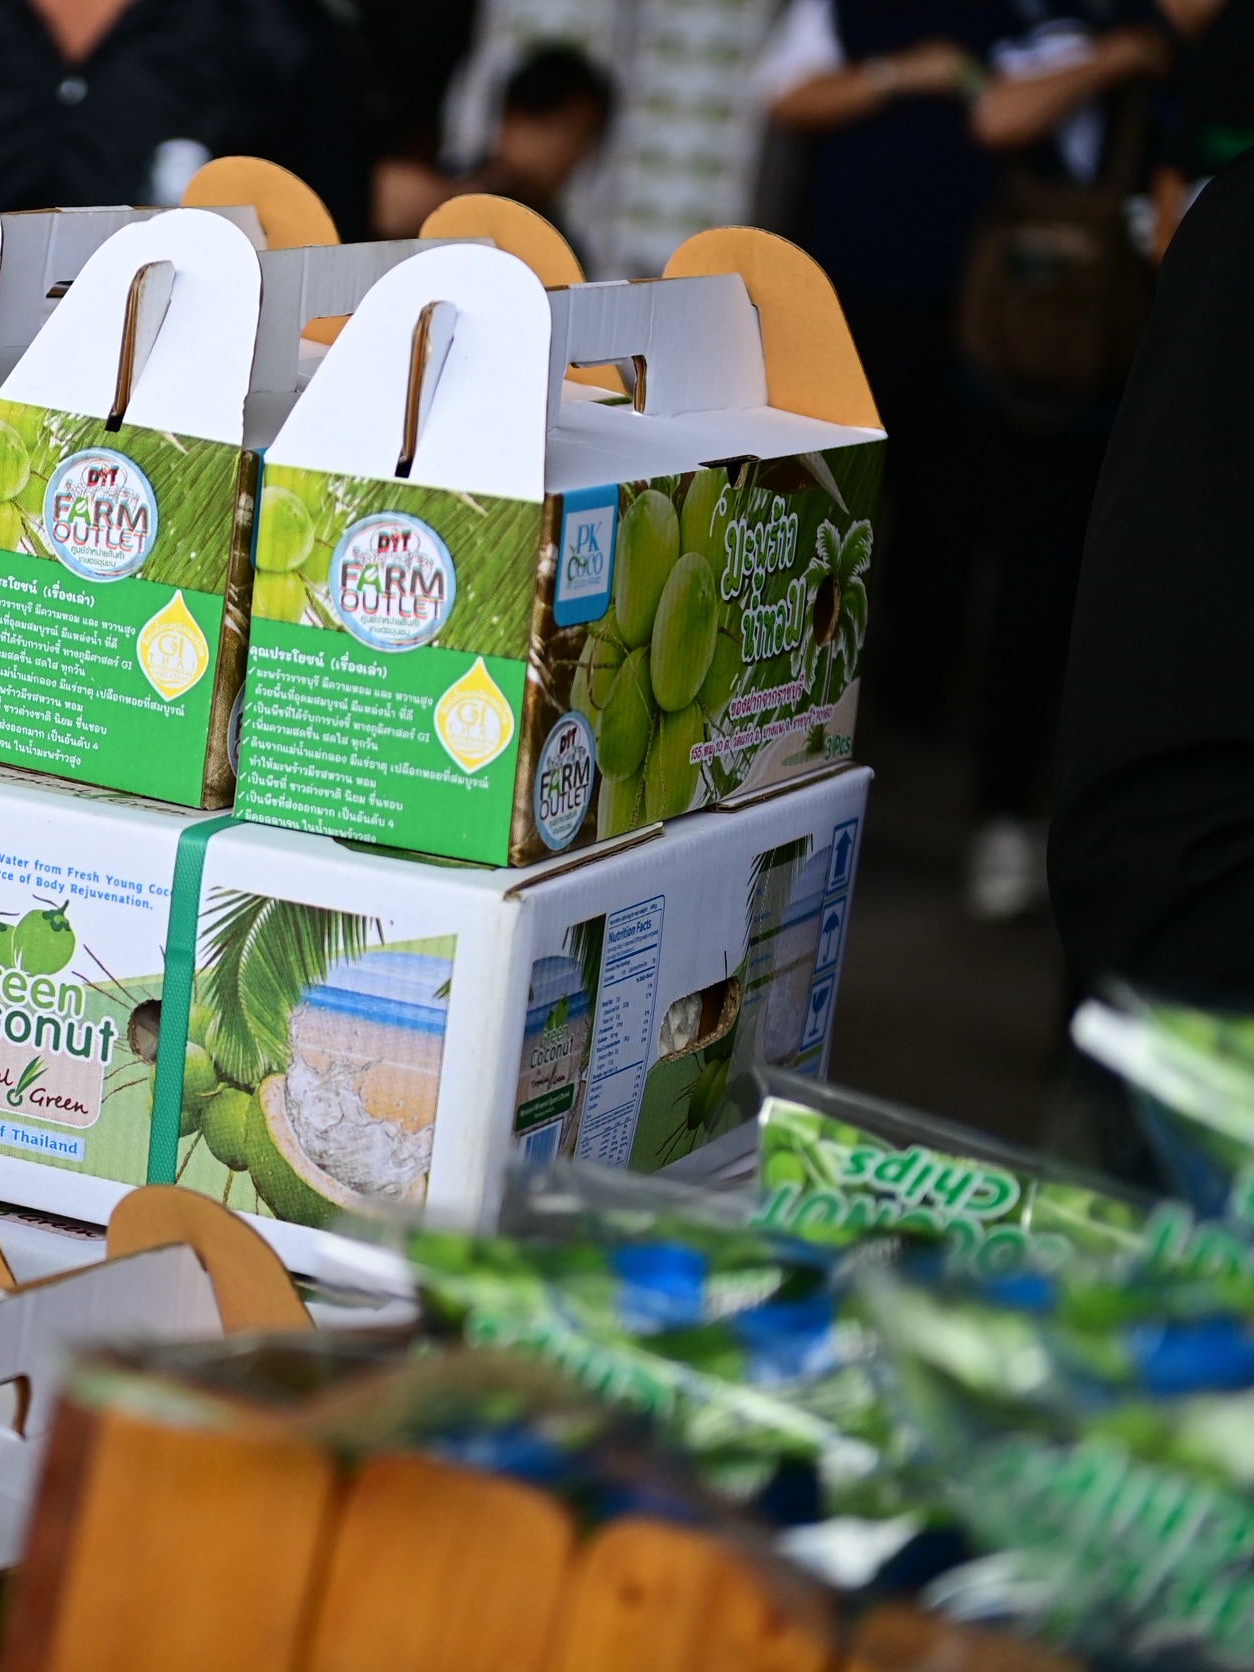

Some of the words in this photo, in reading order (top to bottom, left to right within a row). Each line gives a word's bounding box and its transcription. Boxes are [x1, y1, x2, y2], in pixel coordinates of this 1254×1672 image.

[54, 492, 149, 534] FARM
[53, 520, 149, 553] OUTLET
[577, 522, 602, 554] PK
[341, 560, 444, 599] FARM
[341, 590, 444, 621] OUTLET
[540, 756, 590, 801] FARM
[539, 784, 590, 821] OUTLET
[19, 873, 31, 885] of
[36, 876, 65, 893] Body
[70, 883, 153, 910] Rejuvenation.
[33, 859, 62, 875] from
[67, 867, 100, 883] Fresh
[105, 874, 143, 894] Young
[531, 1036, 573, 1069] Coconut
[29, 1087, 89, 1115] Green
[11, 1128, 78, 1154] Thailand
